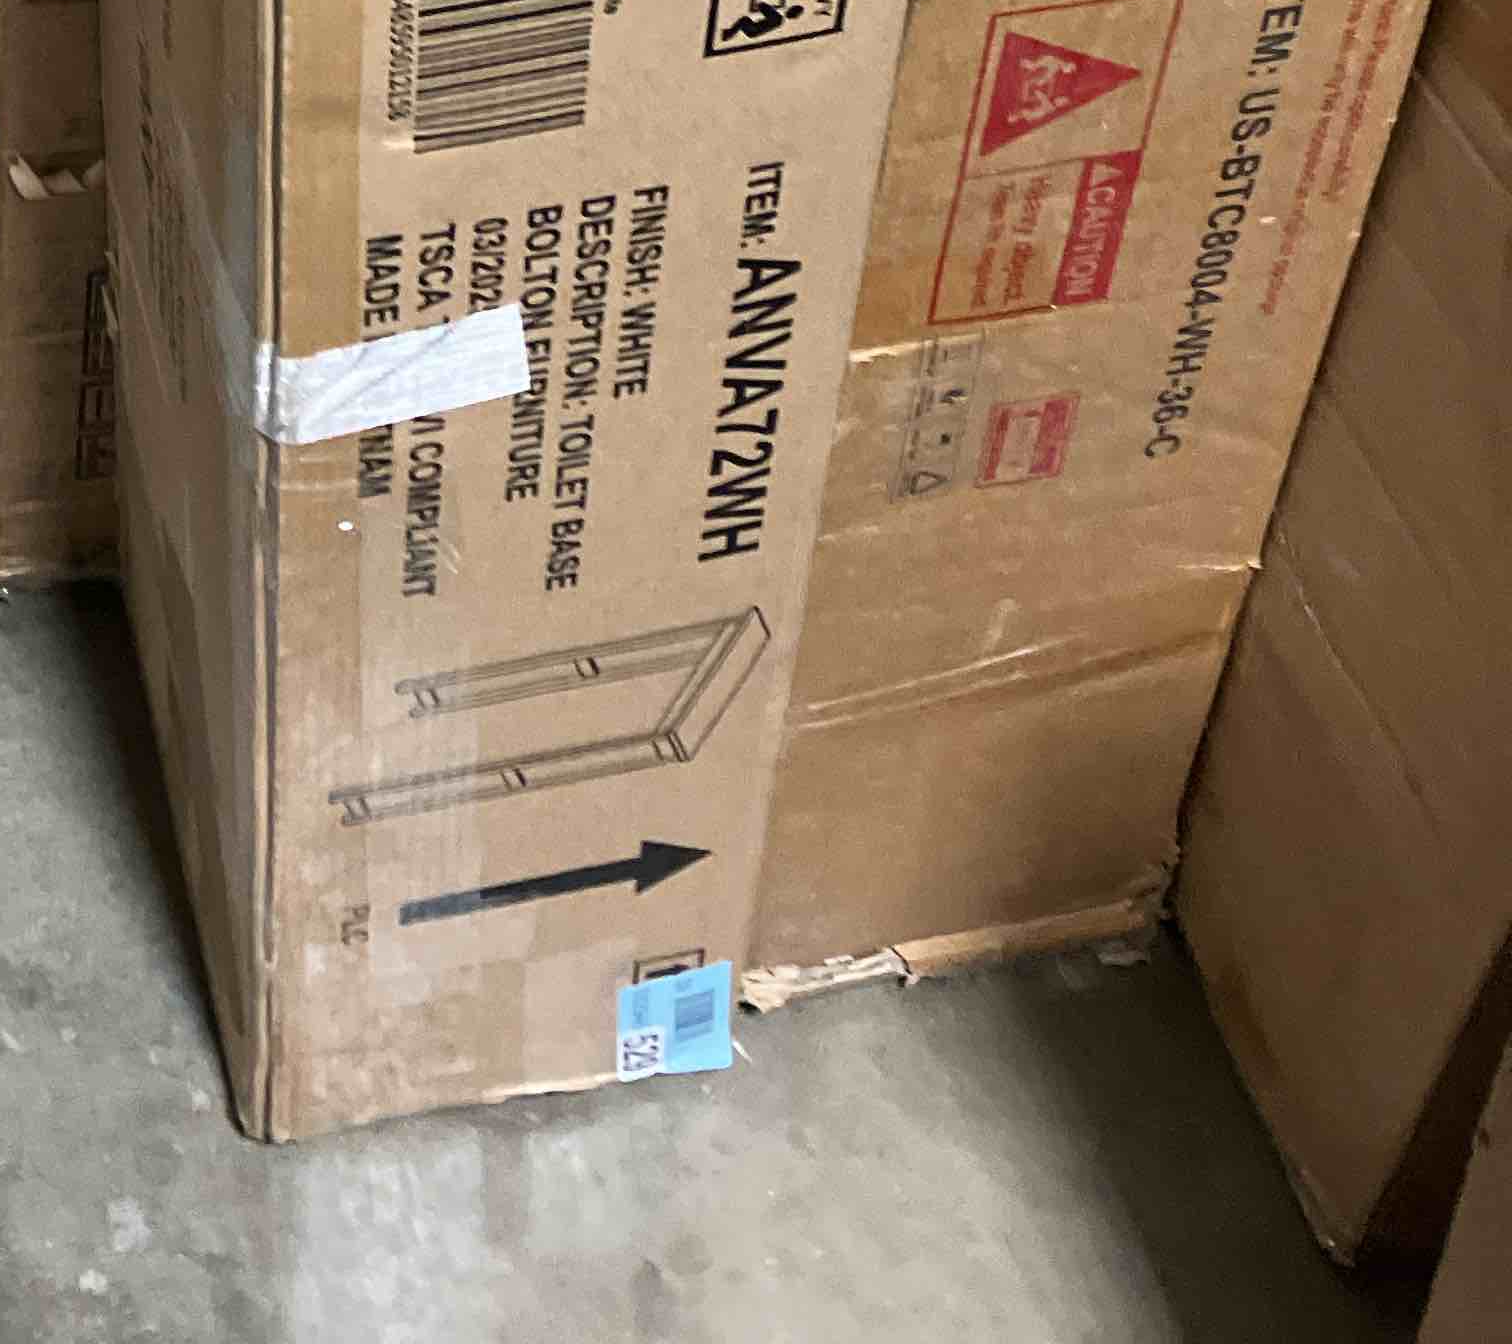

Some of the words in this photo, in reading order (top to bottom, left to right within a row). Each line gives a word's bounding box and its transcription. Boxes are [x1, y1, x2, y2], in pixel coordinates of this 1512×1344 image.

[623, 185, 670, 298] FINISH:
[740, 161, 785, 248] ITEM:
[1065, 184, 1117, 298] CAUTION
[364, 233, 403, 326] MADE
[416, 223, 456, 312] TSCA
[519, 204, 564, 341] BOLTON
[562, 194, 617, 410] DESCRIPTION:
[1143, 89, 1281, 459] US-BTC8004-WH-36-C
[613, 298, 657, 399] WHITE
[505, 338, 553, 503] FURNITURE
[554, 413, 594, 511] TOILET
[697, 257, 802, 562] ANVA72WH
[401, 440, 445, 598] COMPLIANT
[545, 517, 585, 592] BASE
[341, 904, 370, 945] PLC
